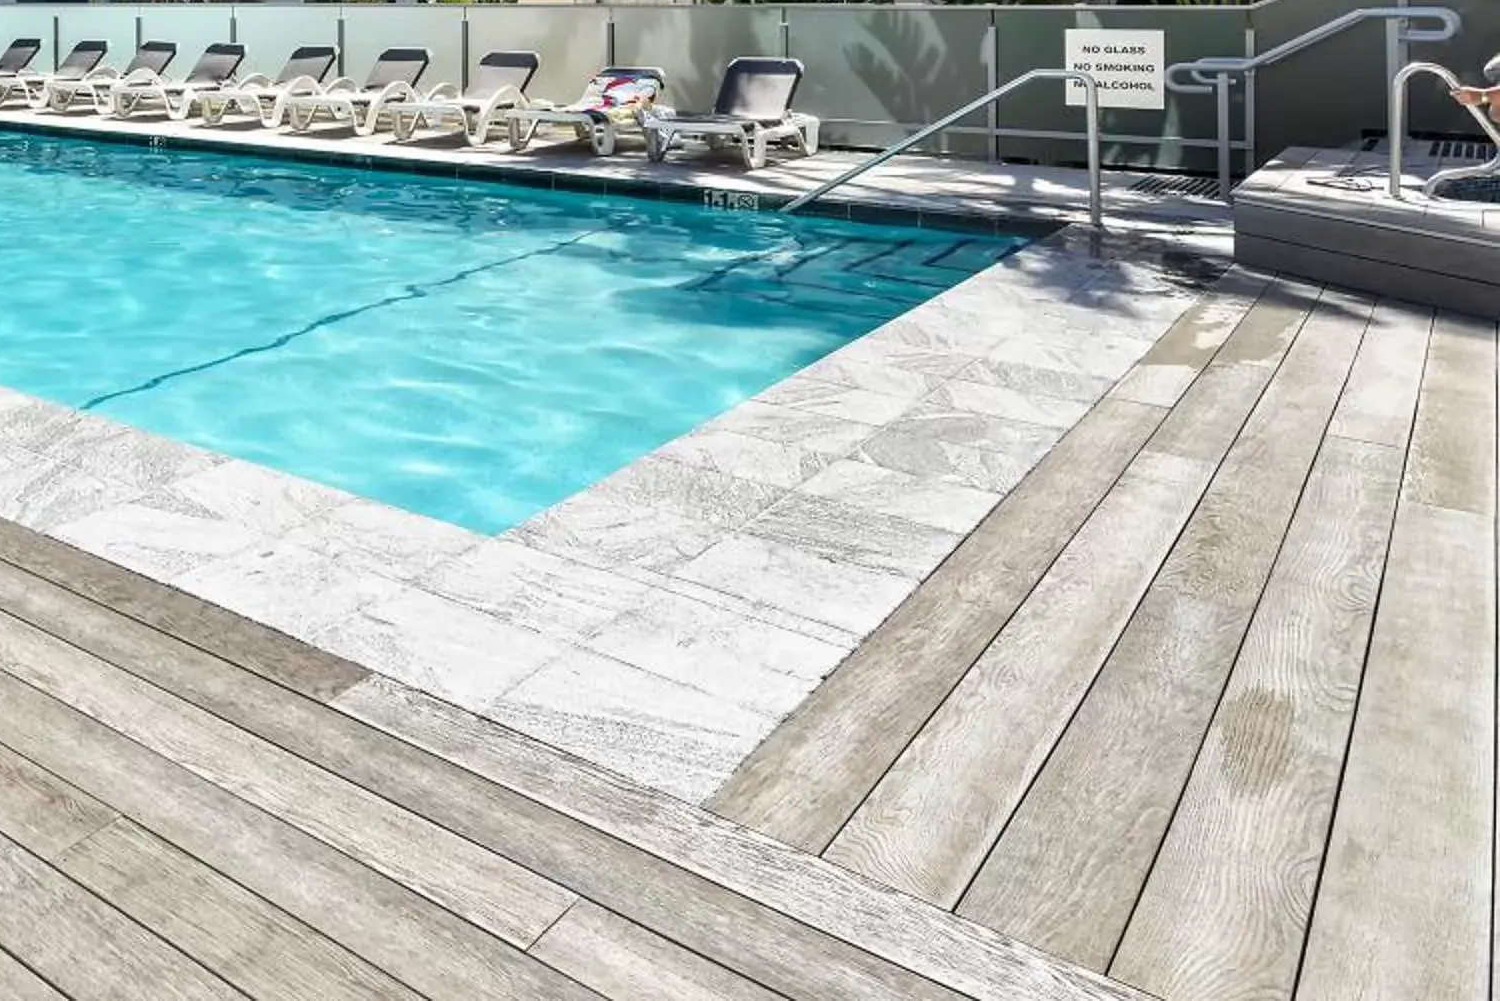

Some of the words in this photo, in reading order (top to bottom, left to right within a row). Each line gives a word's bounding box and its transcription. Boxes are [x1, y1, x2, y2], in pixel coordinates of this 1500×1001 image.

[1083, 46, 1100, 54] NO
[1104, 46, 1146, 55] GLASS
[1073, 62, 1091, 71] NO
[1095, 62, 1155, 73] SMOKING
[1095, 80, 1155, 90] ALCOHOL
